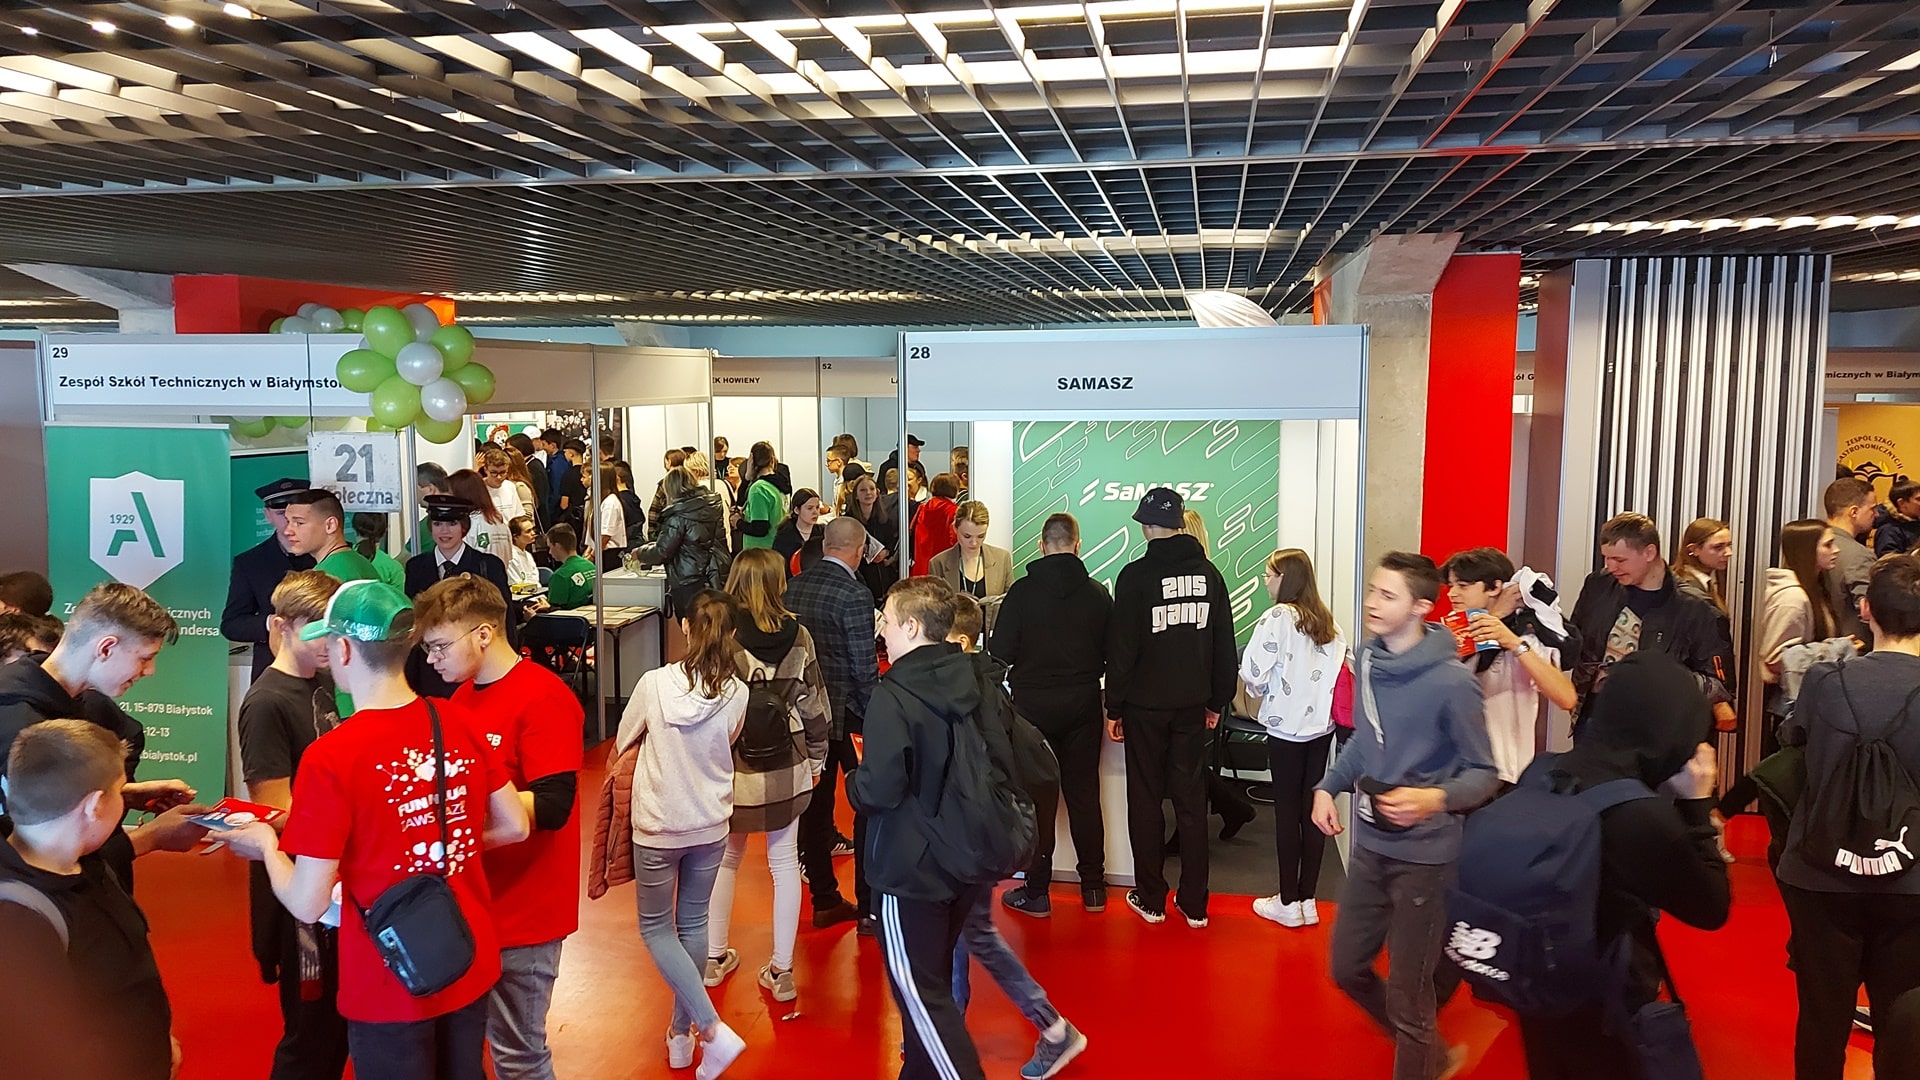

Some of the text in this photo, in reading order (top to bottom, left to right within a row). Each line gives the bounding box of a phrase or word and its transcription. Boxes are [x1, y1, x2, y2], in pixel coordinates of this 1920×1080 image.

[52, 347, 68, 358] 29
[910, 346, 931, 359] 28
[723, 376, 760, 384] HOWIENY
[1825, 371, 1871, 380] micznych
[1887, 371, 1920, 380] Białym
[60, 376, 104, 389] Zespół
[109, 376, 145, 387] Szkół
[150, 376, 245, 390] Technicznych
[250, 379, 262, 388] w
[1057, 376, 1133, 390] SAMASZ
[335, 443, 375, 483] 21
[334, 486, 393, 505] ołeczna
[1102, 482, 1210, 501] SaMSZ
[109, 514, 135, 525] 1929
[1161, 575, 1207, 600] 2115
[168, 607, 211, 620] icznych
[1152, 602, 1210, 634] gang
[180, 624, 219, 637] ndersa
[119, 701, 213, 717] 21, 15-879 Białystok
[142, 727, 170, 738] -12-13
[140, 750, 197, 764] .bialystok.pl
[1834, 848, 1903, 876] PUMA
